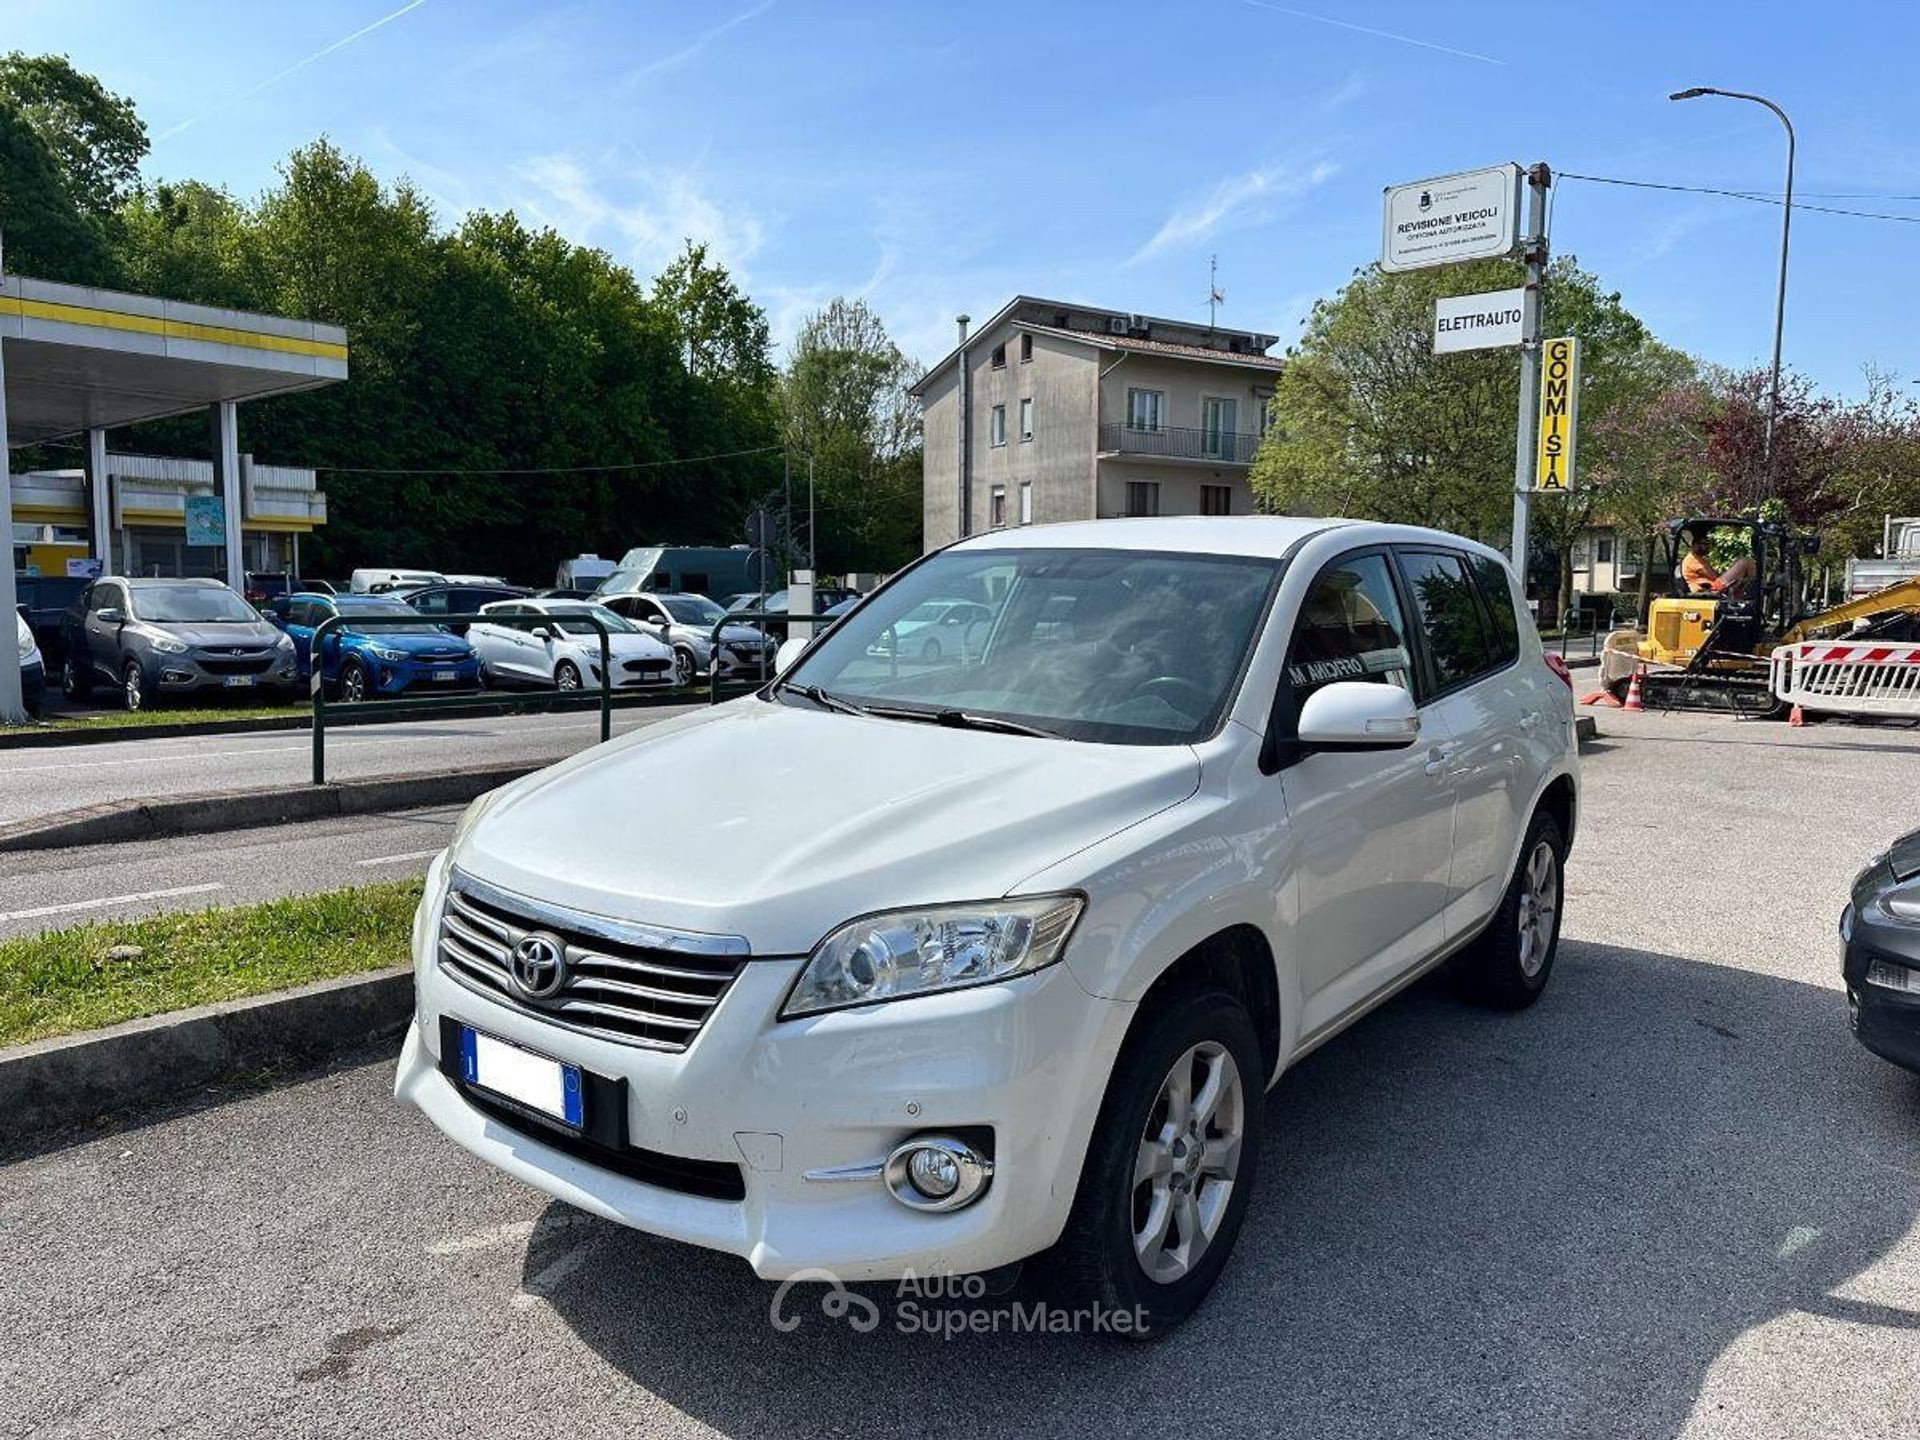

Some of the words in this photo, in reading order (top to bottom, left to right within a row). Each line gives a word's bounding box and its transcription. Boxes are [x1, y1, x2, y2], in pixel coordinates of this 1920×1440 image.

[1397, 214, 1453, 234] REVISIONE
[1454, 206, 1498, 223] VEICOLI
[1438, 221, 1486, 236] AUTORIZZATA
[1438, 309, 1522, 332] ELETTRAUTO
[1543, 341, 1568, 490] GOMMISTA
